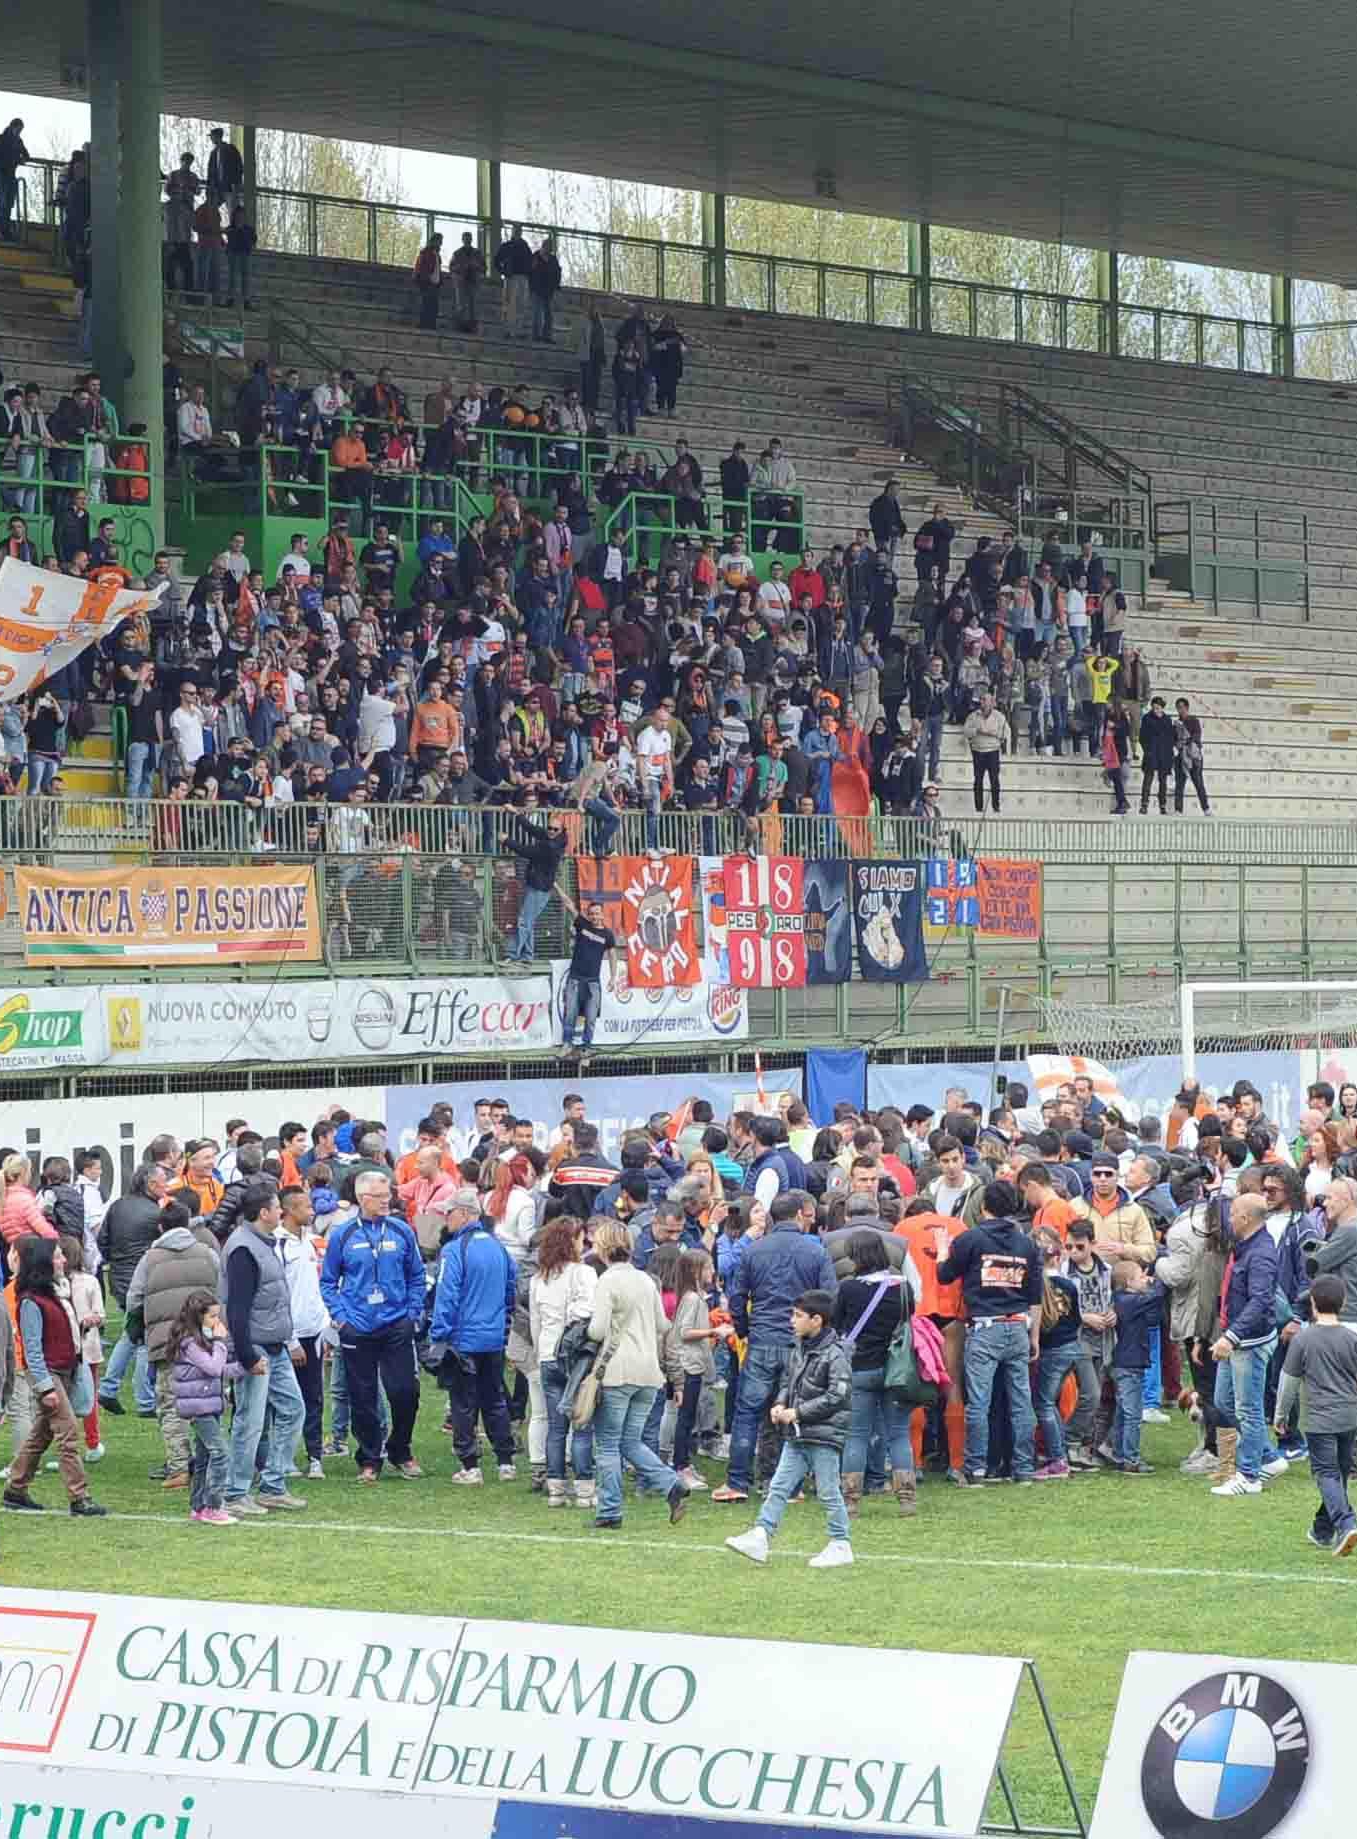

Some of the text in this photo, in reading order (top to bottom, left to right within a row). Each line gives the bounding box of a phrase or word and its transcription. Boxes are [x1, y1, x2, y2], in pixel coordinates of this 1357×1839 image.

[20, 583, 44, 616] 1
[175, 885, 307, 931] PASSIONE
[736, 863, 793, 909] 1 8
[740, 938, 794, 981] 9 8
[148, 1002, 205, 1021] NUOVA
[399, 988, 543, 1047] Effecar
[116, 1625, 698, 1725] CASSA DI RISPARMIO
[1160, 1672, 1306, 1756] BMW
[88, 1701, 951, 1827] DI PISTOIA E DELLA LUCCHESIA
